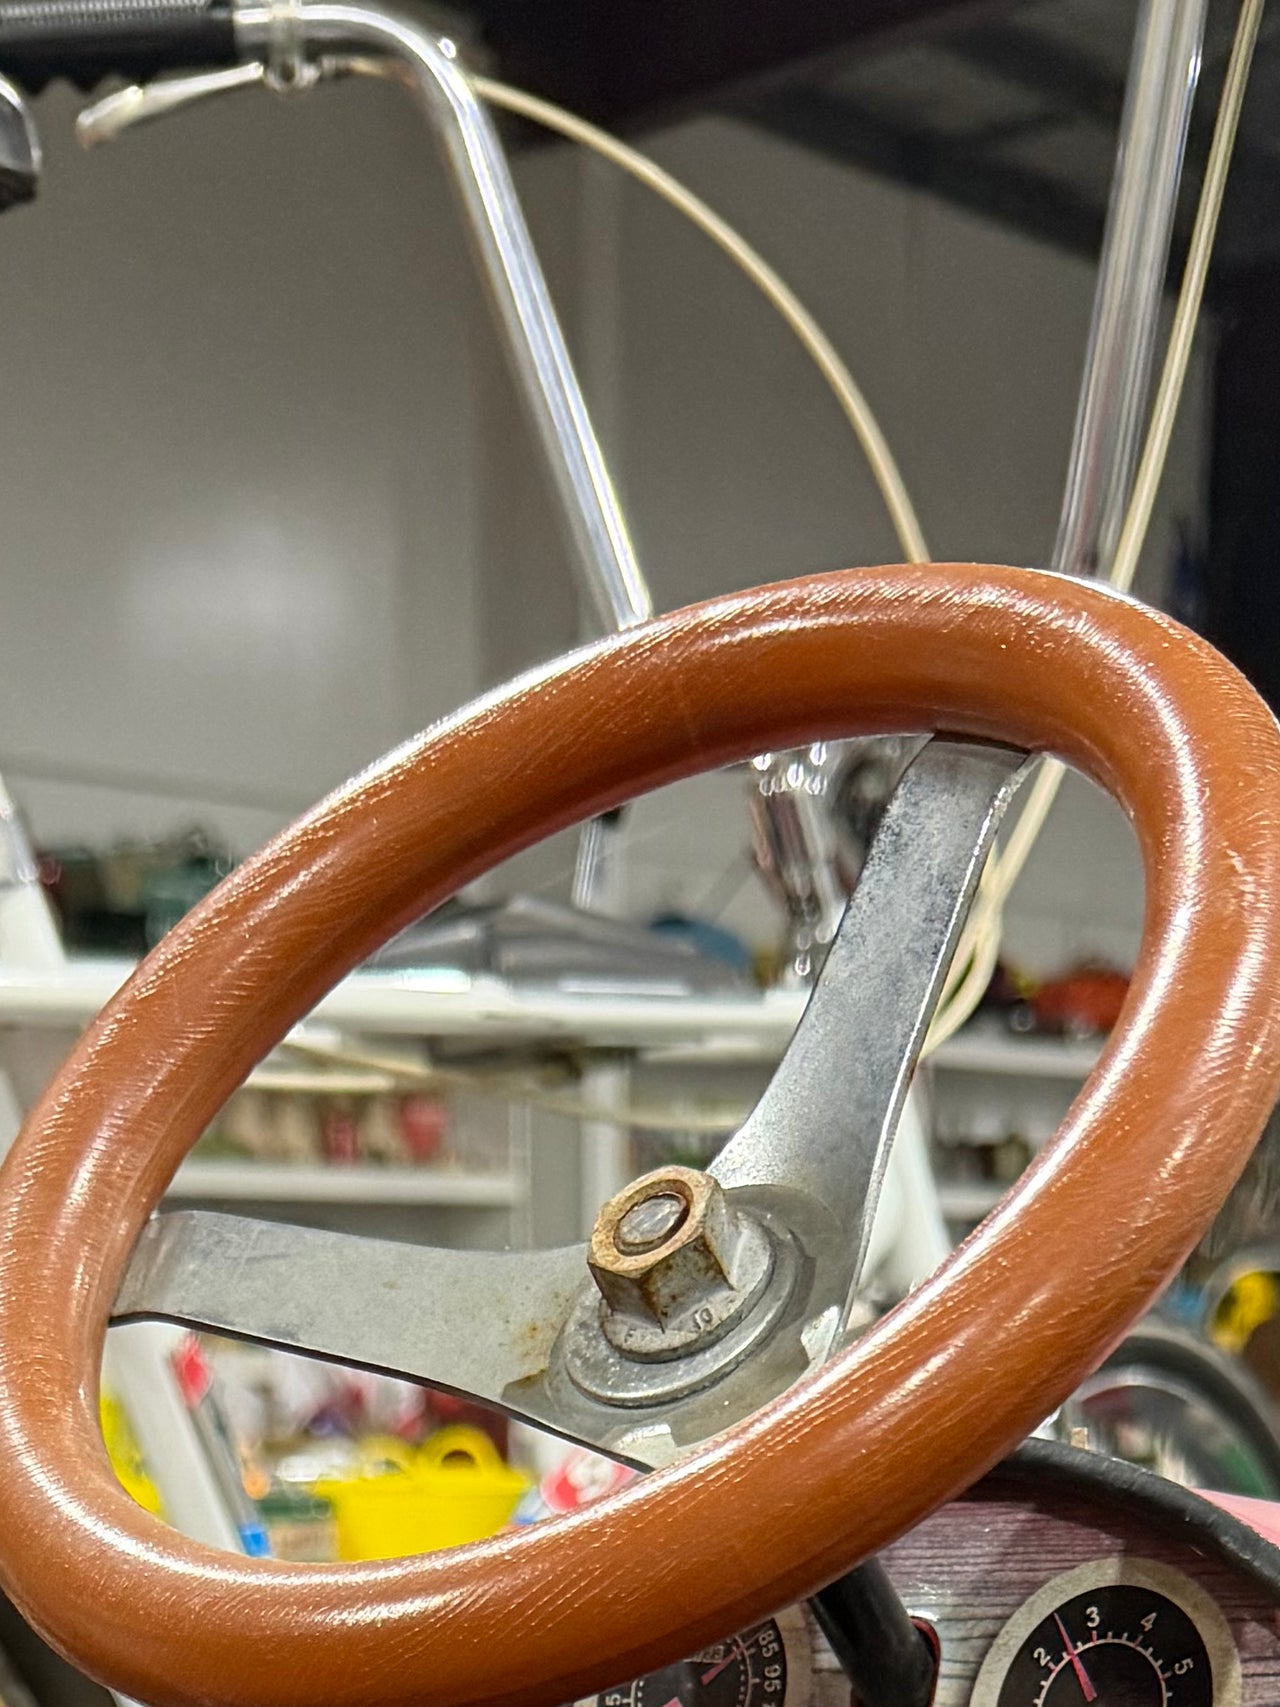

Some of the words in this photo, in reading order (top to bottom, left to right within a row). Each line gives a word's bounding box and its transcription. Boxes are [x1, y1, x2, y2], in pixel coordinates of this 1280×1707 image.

[758, 1629, 780, 1659] 85
[1032, 1646, 1052, 1667] 2
[1085, 1606, 1101, 1628] 3
[1139, 1611, 1158, 1633] 4
[1173, 1657, 1195, 1676] 5
[763, 1664, 783, 1693] 95
